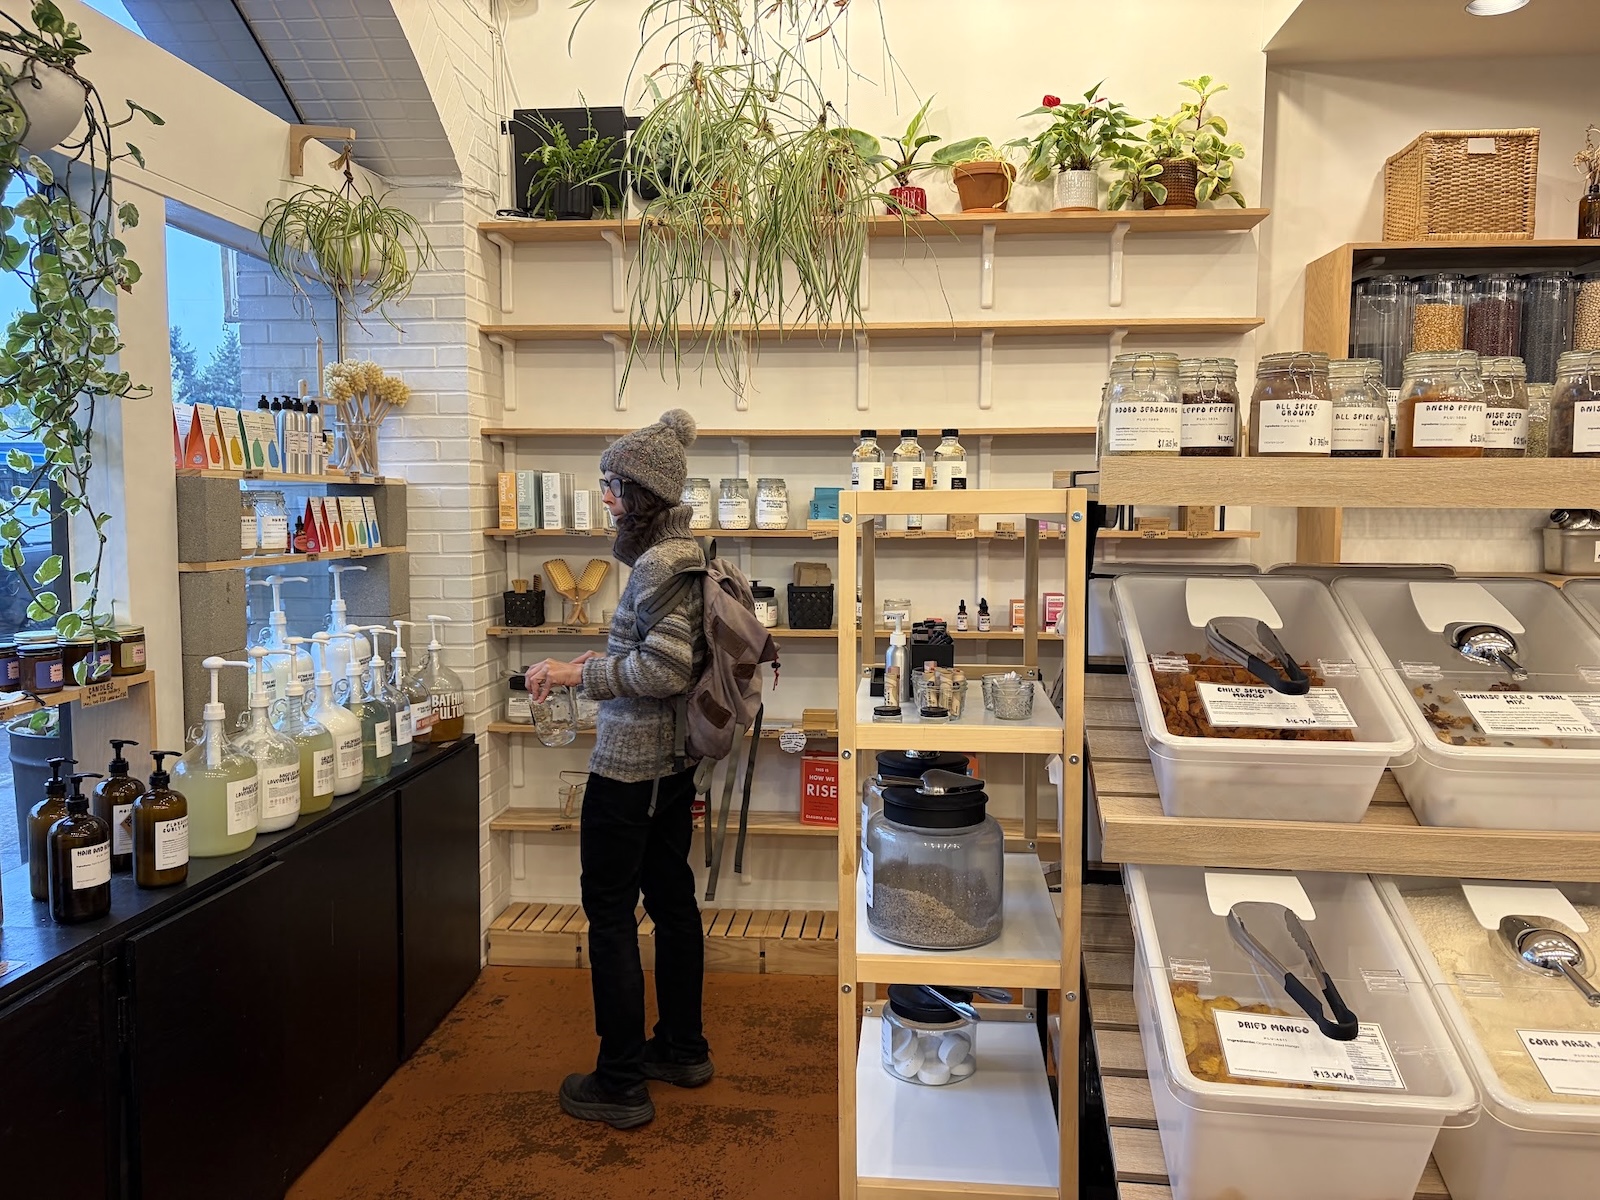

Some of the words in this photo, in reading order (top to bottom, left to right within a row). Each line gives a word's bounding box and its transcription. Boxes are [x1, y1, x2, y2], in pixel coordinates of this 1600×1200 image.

[1115, 406, 1137, 414] ADOBO
[1140, 406, 1178, 414] SEASONING
[1182, 406, 1206, 414] LEPPO
[1491, 419, 1517, 427] WHOLE
[518, 472, 526, 502] Davids
[89, 682, 114, 694] CANDLES
[806, 783, 837, 799] RISE
[93, 846, 103, 854] AND
[1237, 1020, 1267, 1030] DRIED
[1270, 1024, 1309, 1034] MANGO
[1529, 1038, 1559, 1047] CORN
